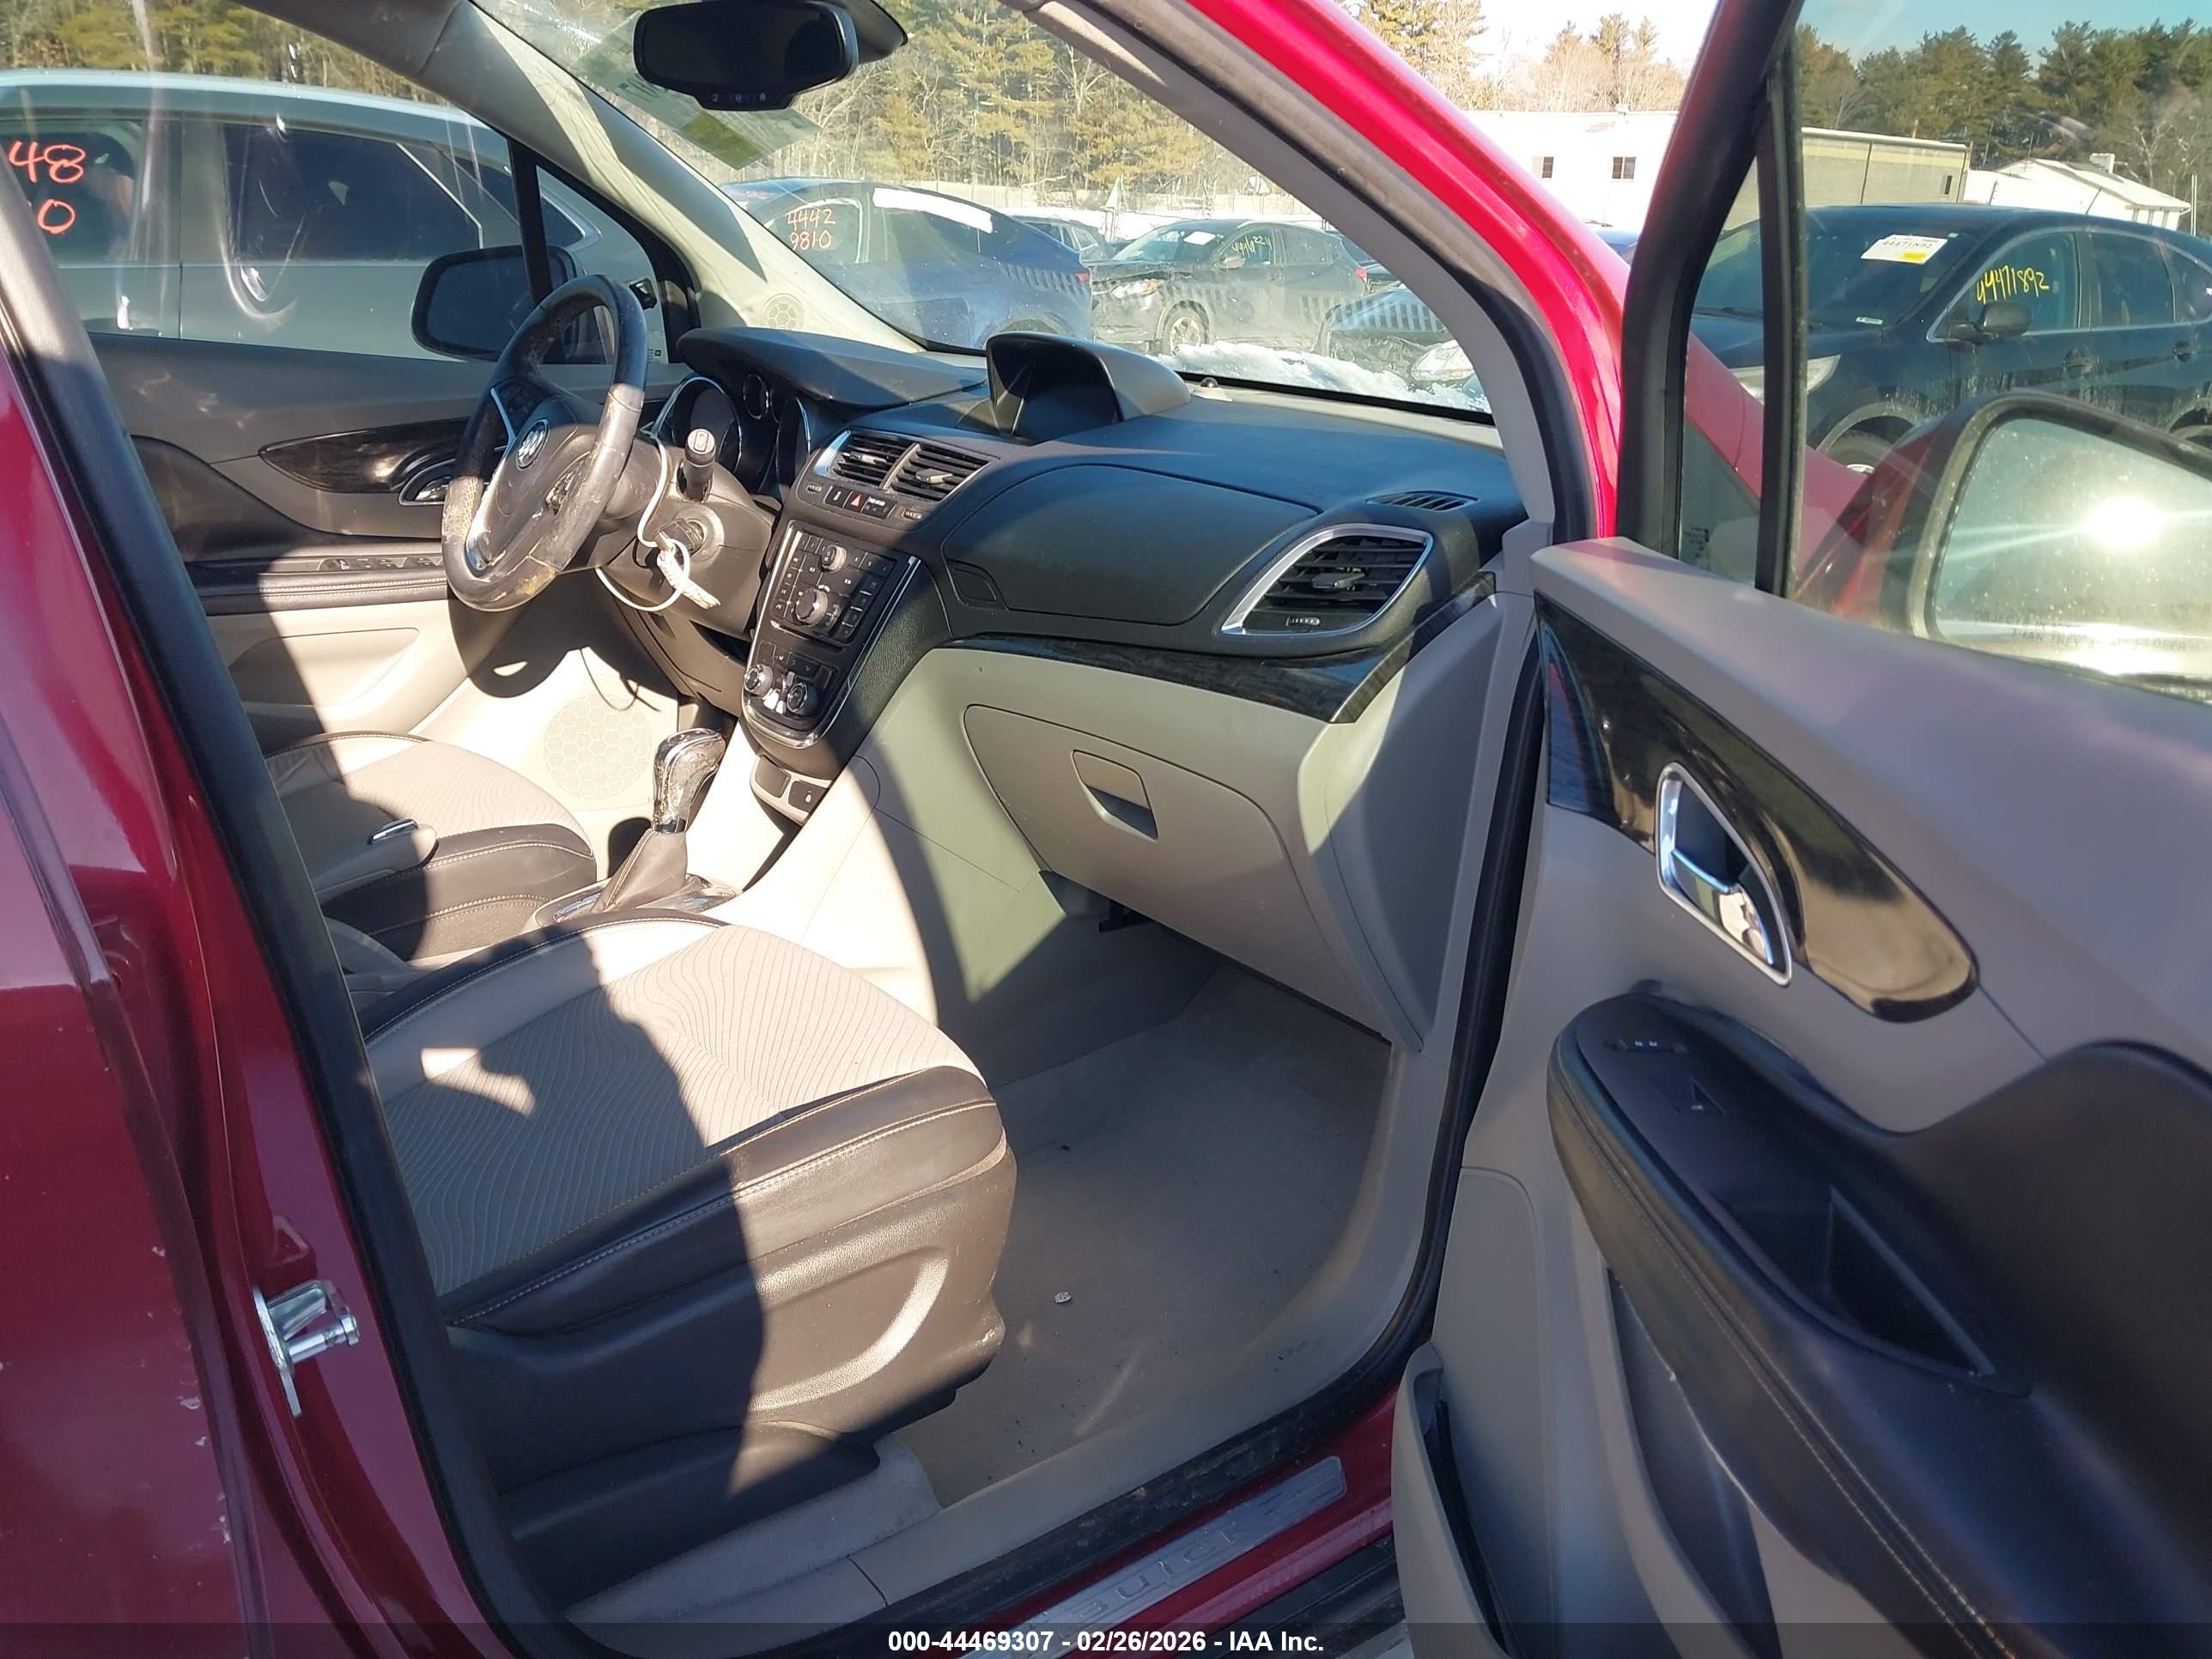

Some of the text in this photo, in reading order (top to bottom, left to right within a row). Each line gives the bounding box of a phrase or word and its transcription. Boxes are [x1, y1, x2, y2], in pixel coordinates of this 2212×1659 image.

[9, 140, 87, 184] 48
[28, 198, 76, 234] 0
[787, 208, 836, 232] 4442
[790, 229, 832, 251] 9810
[1977, 264, 2051, 305] 44471892
